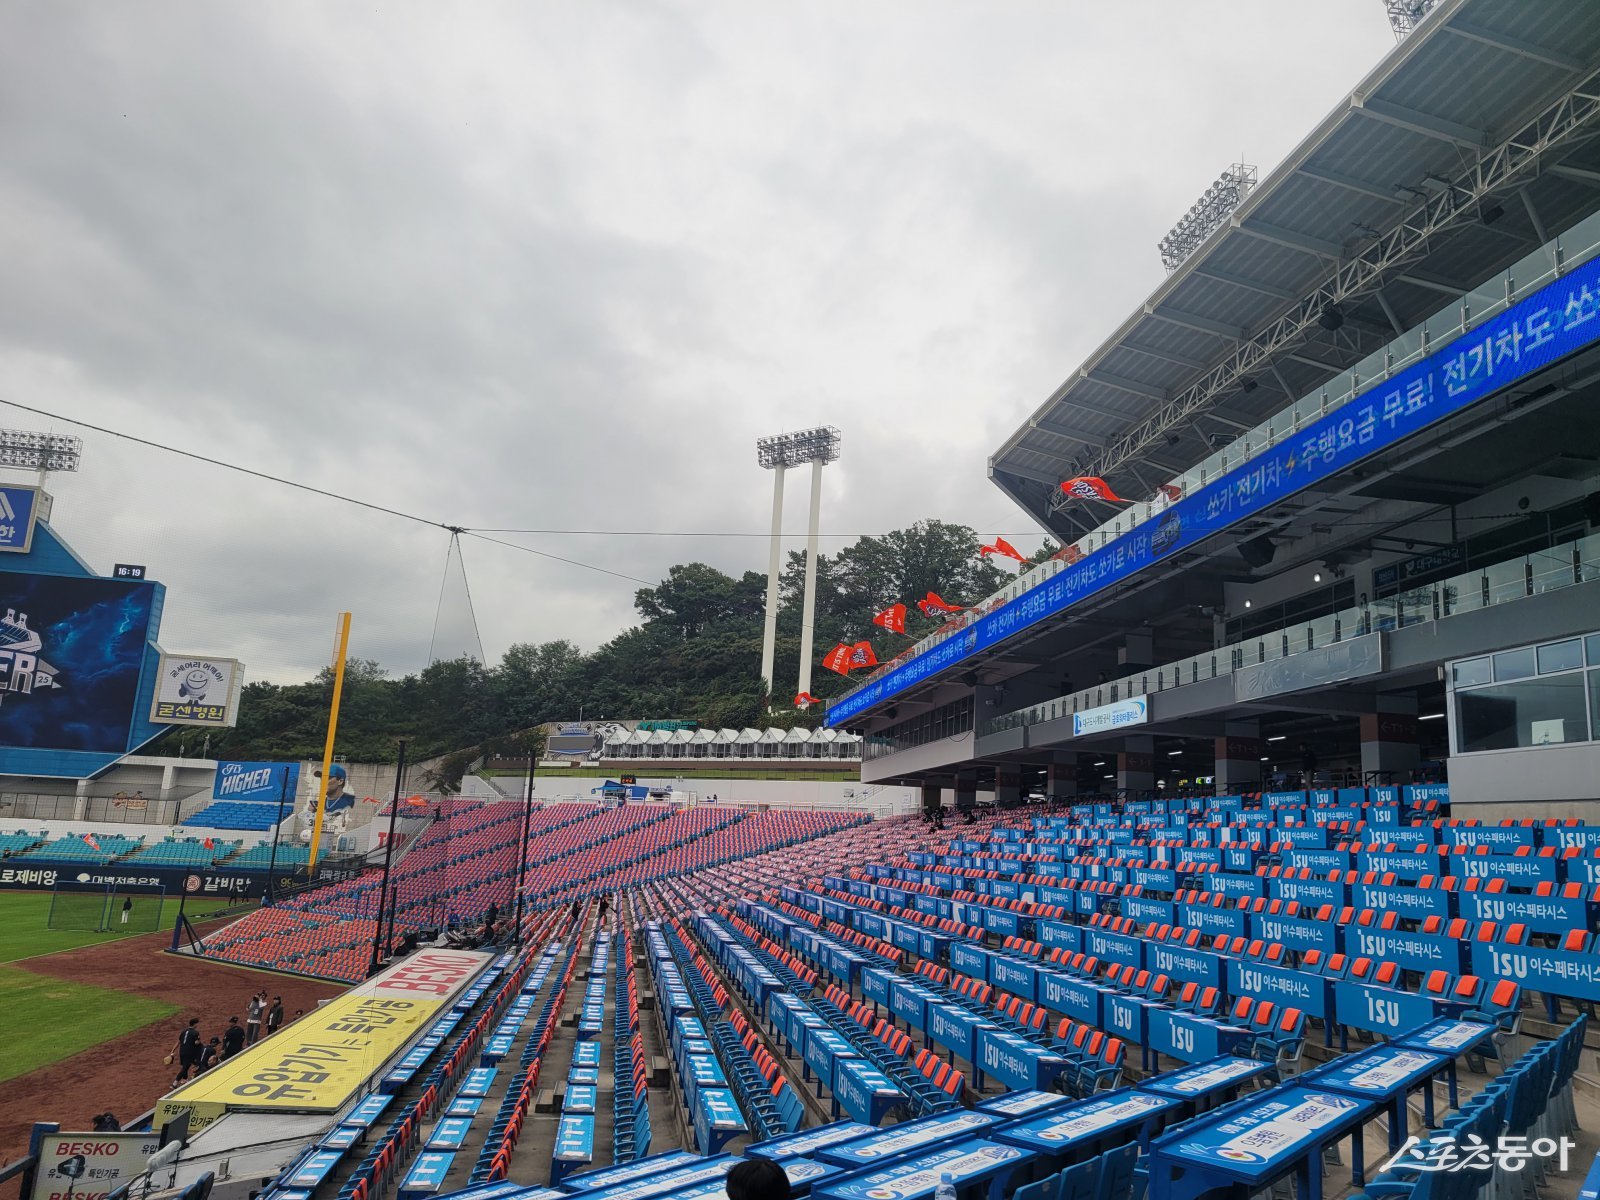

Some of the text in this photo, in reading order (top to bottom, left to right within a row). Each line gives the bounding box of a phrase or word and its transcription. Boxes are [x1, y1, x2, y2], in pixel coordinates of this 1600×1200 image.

[1208, 485, 1233, 521] 쏘카
[1237, 457, 1280, 504] 전기차
[1302, 409, 1376, 472] 주행요금
[1382, 376, 1435, 429] 무료!
[1443, 307, 1554, 398] 전기차도
[1099, 549, 1125, 577] 쏘카로
[1127, 533, 1150, 563] 시작
[118, 567, 141, 577] 16:19
[38, 675, 49, 684] 25
[159, 704, 223, 719] 굳센병원
[220, 768, 272, 795] HIGHER
[1315, 791, 1329, 804] ISU
[1376, 788, 1391, 801] ISU
[1411, 787, 1428, 800] ISU
[1312, 809, 1327, 823] ISU
[1373, 808, 1391, 822] ISU
[1246, 829, 1261, 842] ISU
[1276, 829, 1291, 842] ISU
[1369, 829, 1389, 844] ISU
[1453, 829, 1476, 846] ISU
[1556, 829, 1586, 849] ISU
[1230, 850, 1245, 865] ISU
[1291, 851, 1308, 868] ISU
[1367, 854, 1388, 872] ISU
[1111, 868, 1123, 881] ISU
[1462, 857, 1488, 877] ISU
[1, 870, 57, 886] 로제비앙
[1135, 870, 1147, 884] ISU
[1210, 874, 1255, 891] ISU 이수페타시스
[1278, 879, 1297, 898] ISU
[1363, 886, 1387, 908] ISU
[1080, 894, 1092, 909] ISU
[1127, 899, 1141, 917] ISU
[1473, 894, 1505, 920] ISU
[1185, 907, 1234, 927] ISU 이수페타시스
[1261, 916, 1281, 940] ISU
[1091, 933, 1106, 954] ISU
[1358, 929, 1386, 956] ISU
[1155, 946, 1208, 974] ISU 이수페타시스
[1489, 946, 1527, 978] ISU
[376, 954, 481, 993] BESKO
[1238, 964, 1262, 993] ISU
[1045, 976, 1060, 1003] ISU
[1113, 1000, 1132, 1030] ISU
[1364, 990, 1400, 1026] ISU
[1169, 1016, 1194, 1053] ISU
[984, 1035, 999, 1069] ISU
[56, 1143, 119, 1156] BESKO
